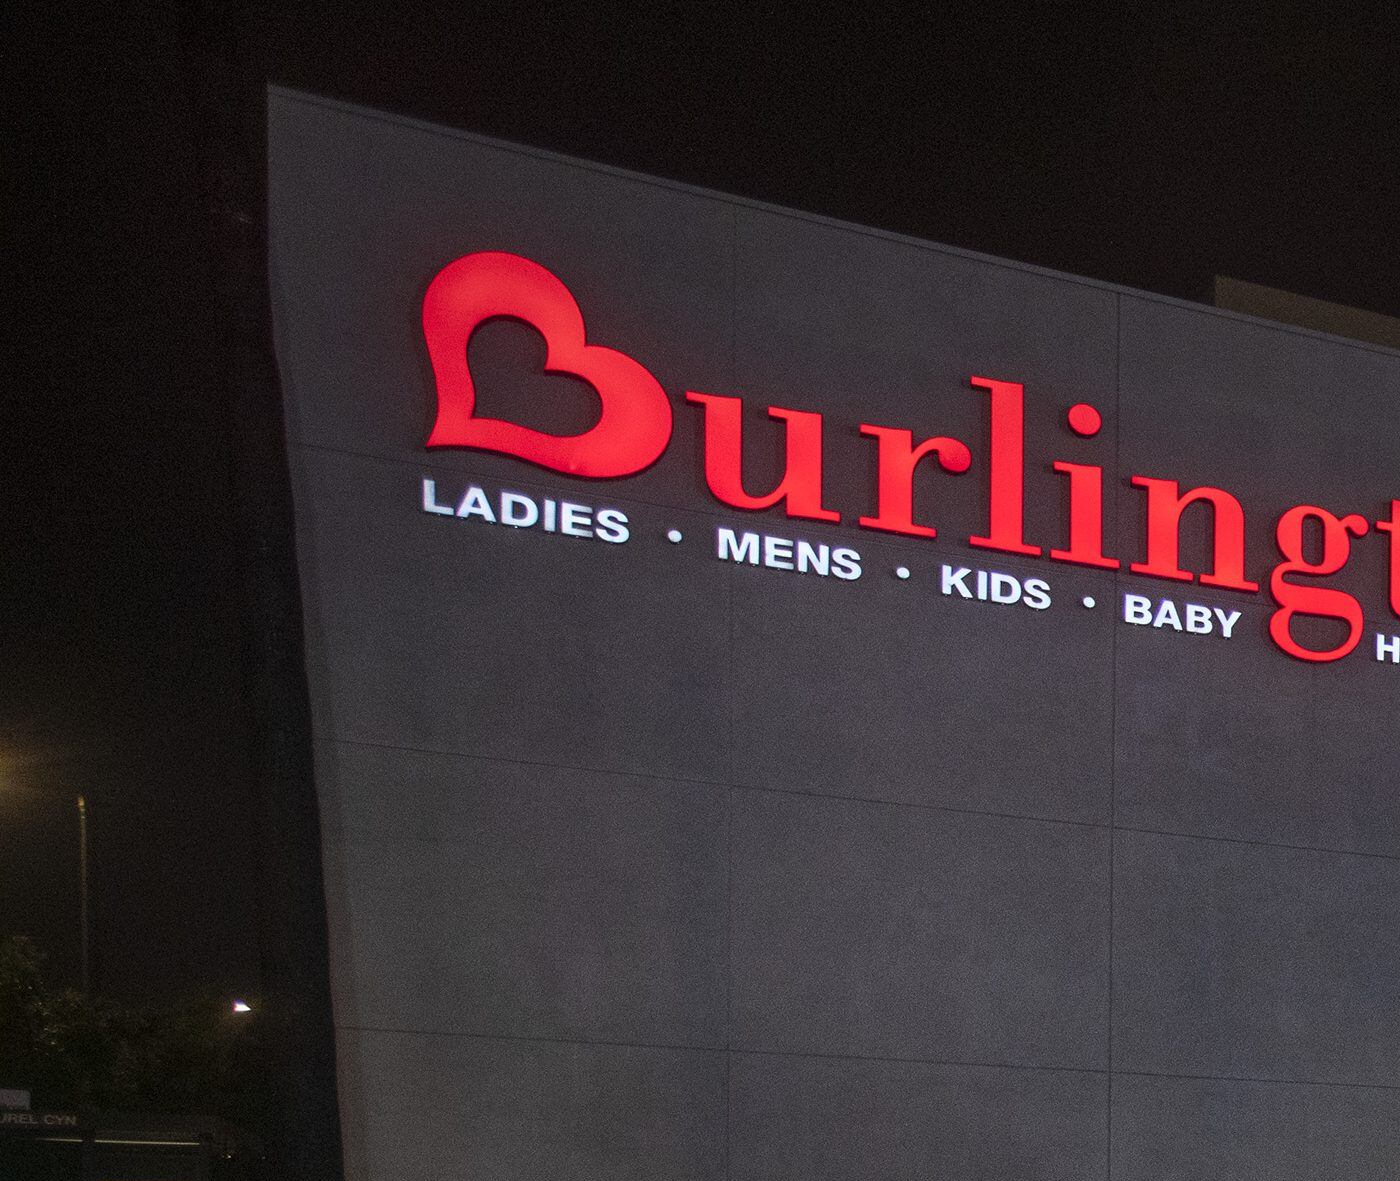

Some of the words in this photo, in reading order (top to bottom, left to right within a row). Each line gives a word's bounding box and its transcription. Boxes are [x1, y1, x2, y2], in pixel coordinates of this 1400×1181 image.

[423, 478, 630, 544] LADIES
[717, 527, 863, 581] MENS
[941, 564, 1052, 612] KIDS
[1124, 593, 1243, 639] BABY
[43, 1114, 77, 1126] CYN
